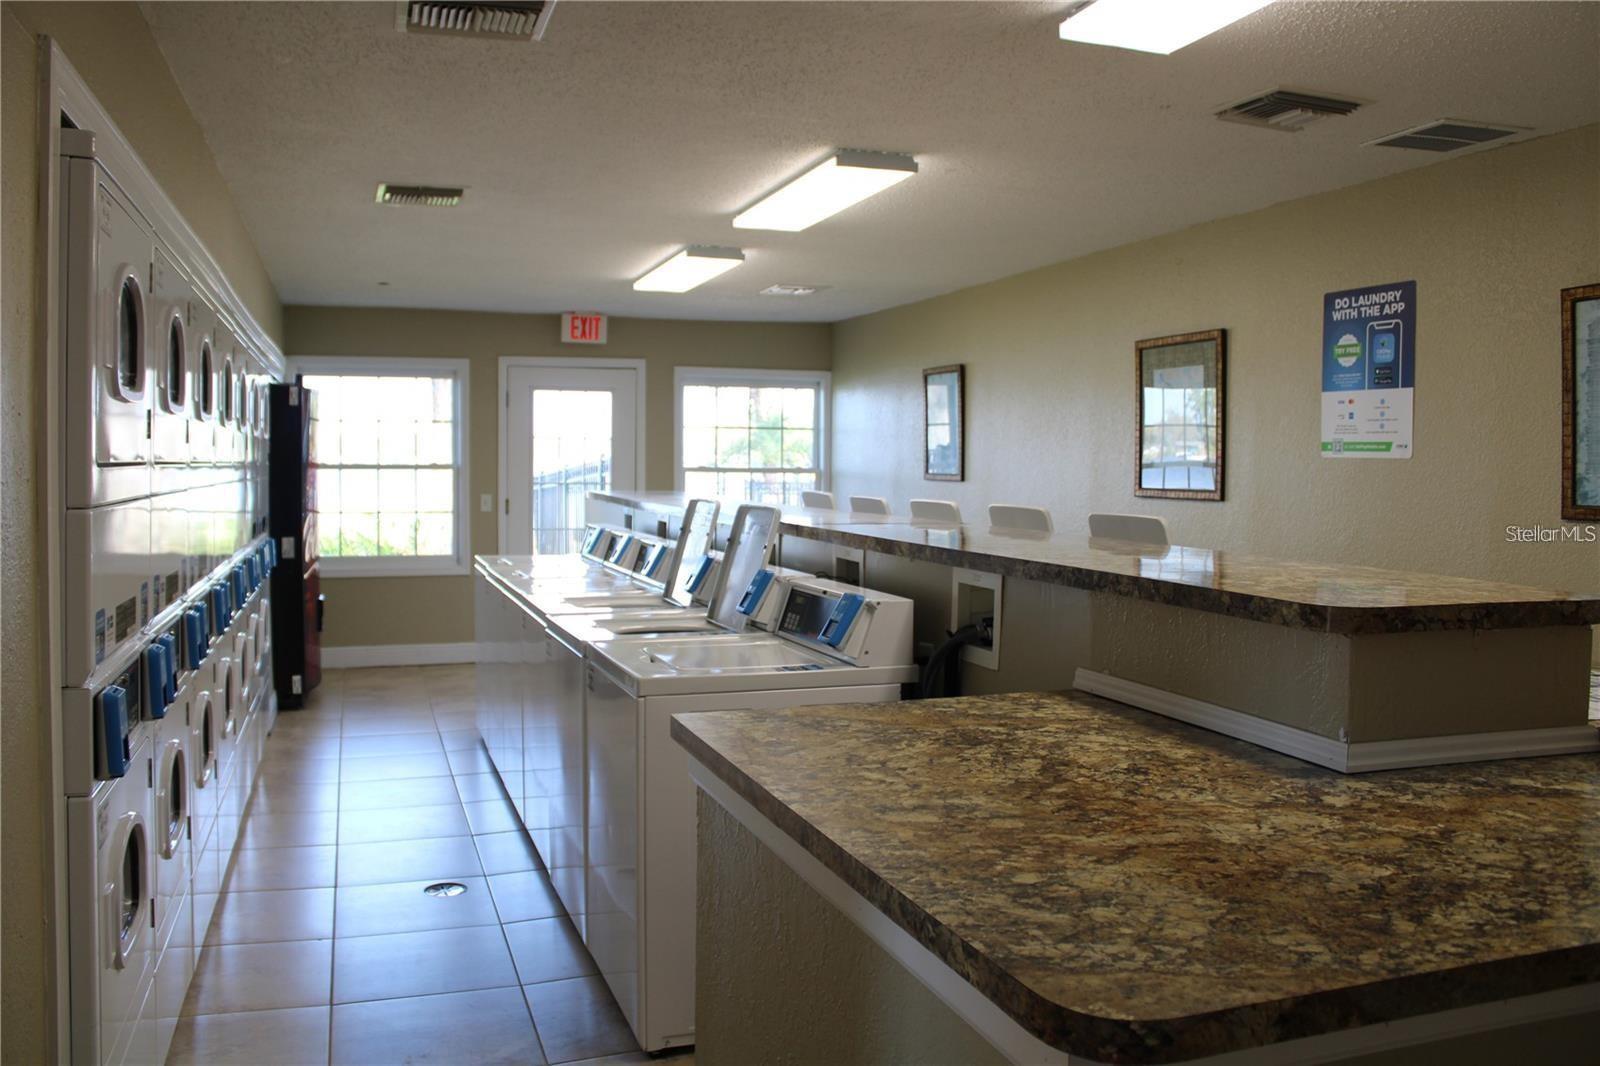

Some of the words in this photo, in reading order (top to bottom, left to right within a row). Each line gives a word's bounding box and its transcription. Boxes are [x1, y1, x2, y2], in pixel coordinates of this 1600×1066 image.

[1335, 298, 1349, 309] DO
[1352, 290, 1402, 307] LAUNDRY
[1332, 308, 1358, 321] WITH
[1360, 305, 1381, 317] THE
[1383, 302, 1405, 315] APP
[570, 316, 601, 340] EXIT
